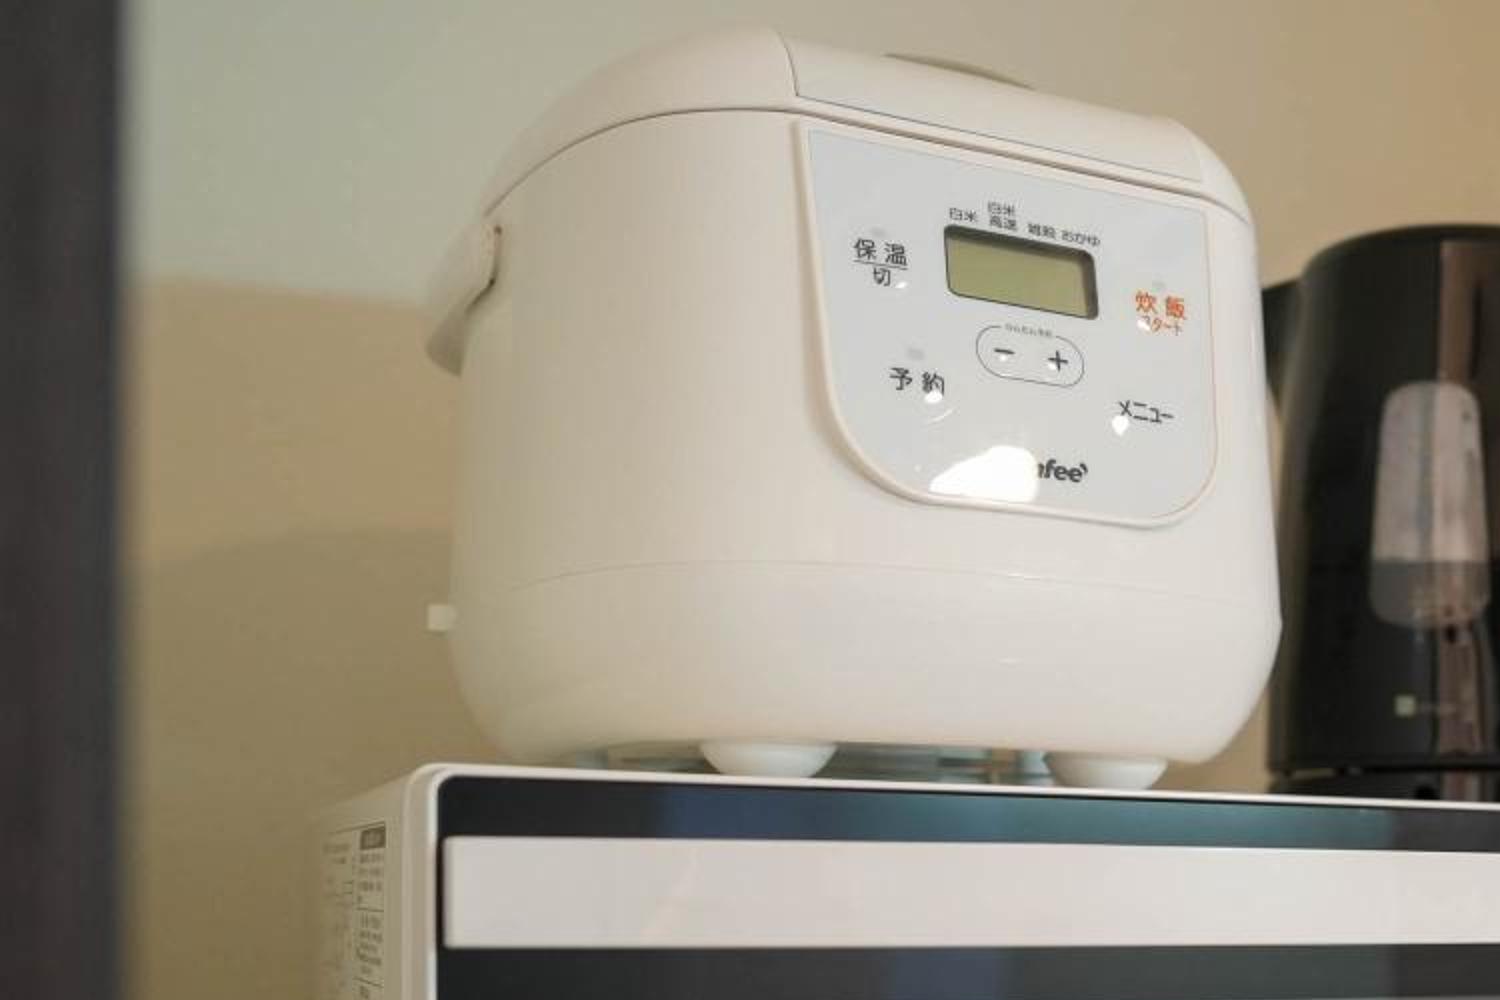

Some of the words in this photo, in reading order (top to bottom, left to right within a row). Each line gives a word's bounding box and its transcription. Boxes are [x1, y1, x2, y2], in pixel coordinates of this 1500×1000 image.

[853, 238, 908, 267] 保温
[872, 267, 892, 287] 切
[1135, 289, 1187, 320] 炊飯
[888, 366, 946, 395] 予約
[1119, 399, 1175, 424] メニュー
